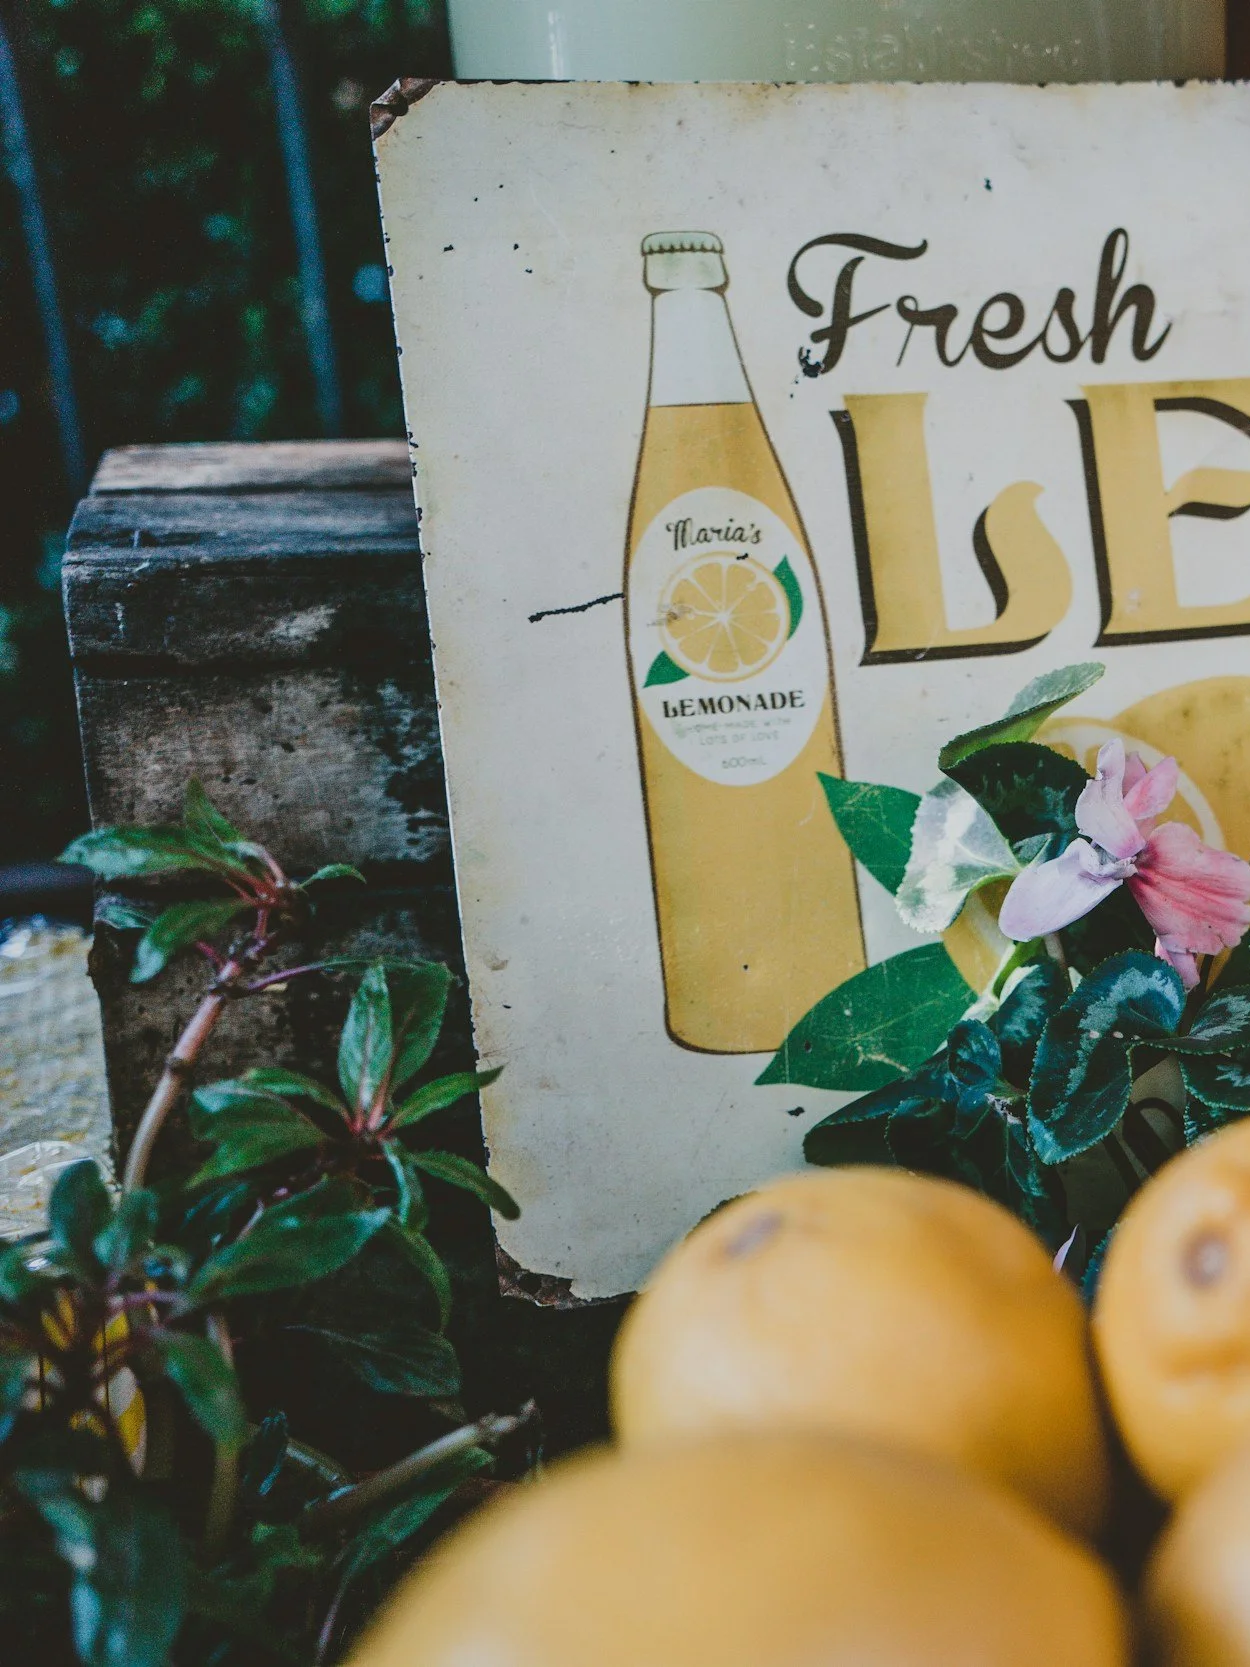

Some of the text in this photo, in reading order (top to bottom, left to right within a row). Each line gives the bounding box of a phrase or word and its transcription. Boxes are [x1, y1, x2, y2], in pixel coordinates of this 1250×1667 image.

[787, 227, 1173, 375] Fresh
[665, 517, 763, 551] Maria's
[662, 689, 806, 719] LEMONADE
